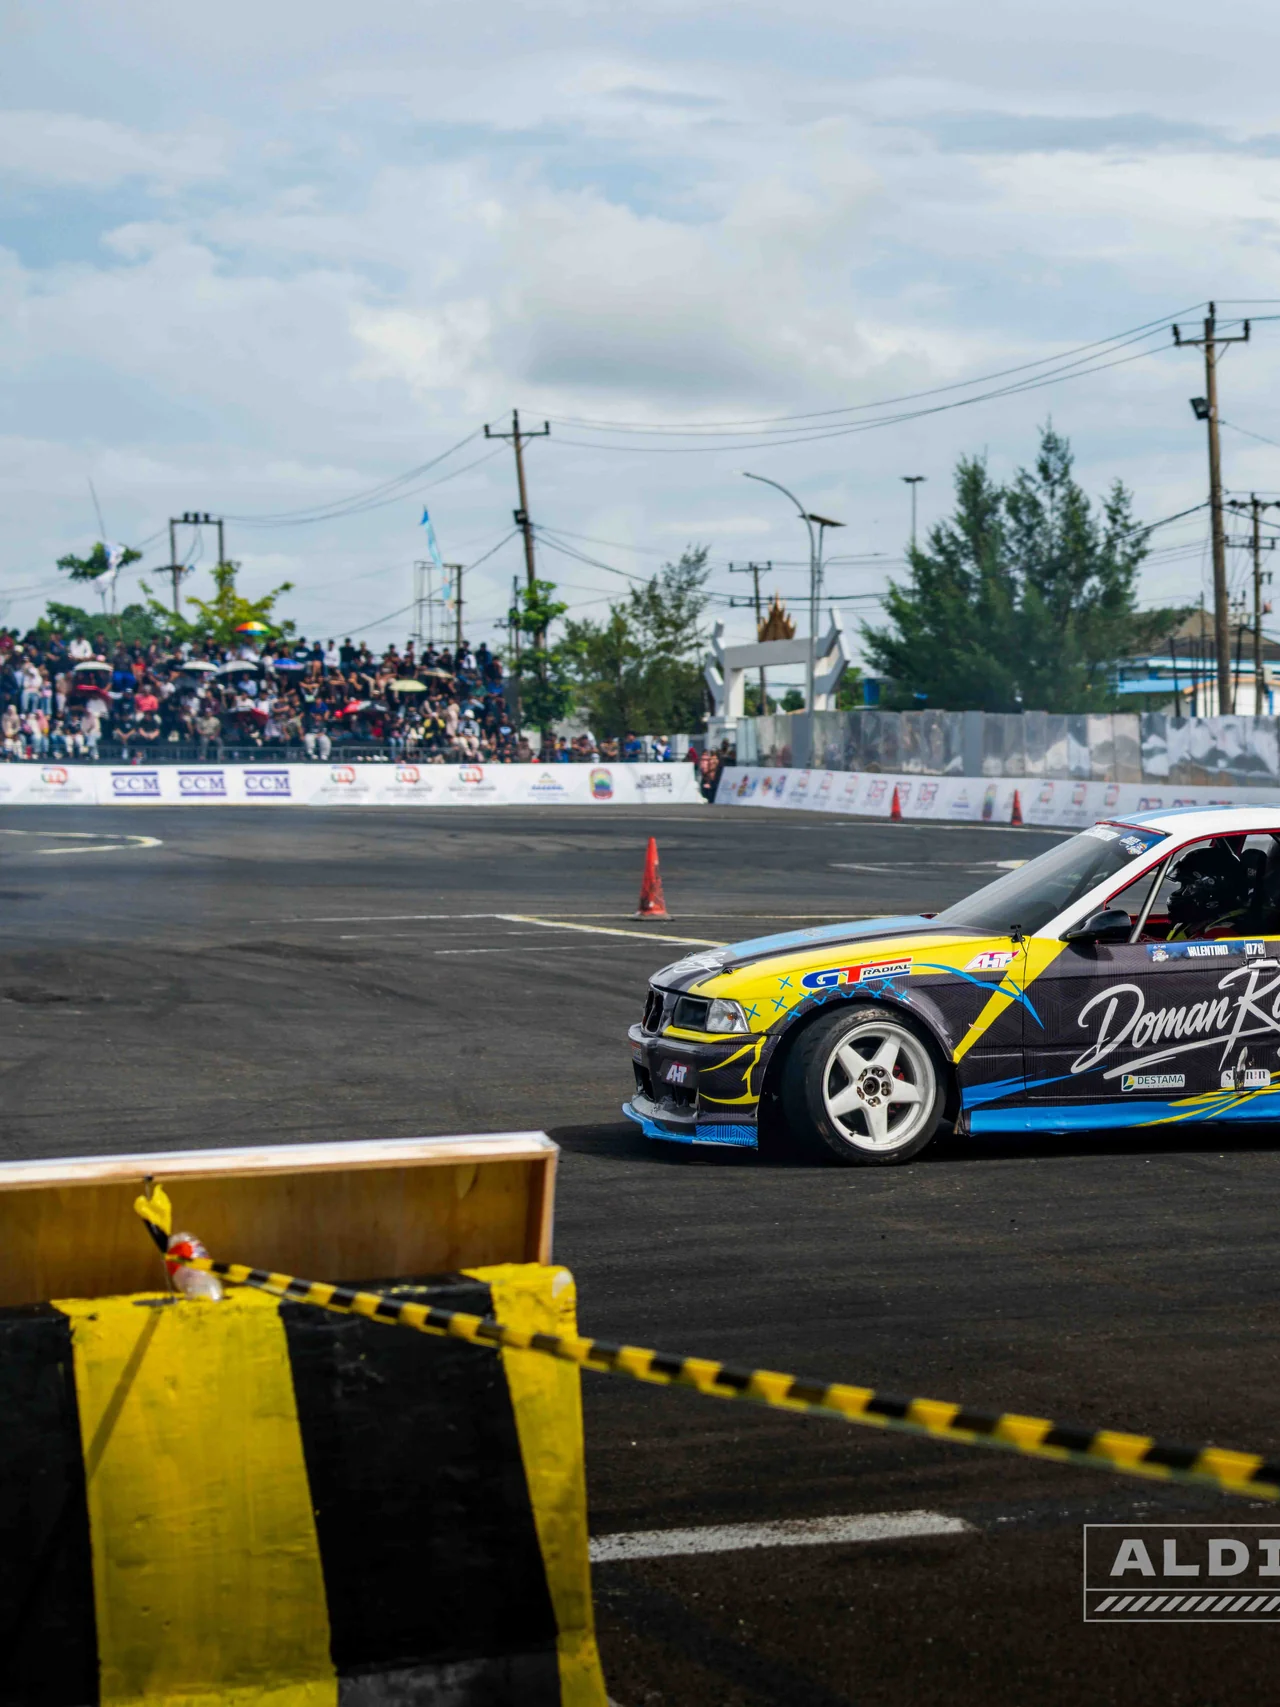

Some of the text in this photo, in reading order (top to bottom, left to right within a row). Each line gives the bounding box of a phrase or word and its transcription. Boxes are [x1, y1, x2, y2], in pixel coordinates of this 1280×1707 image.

[112, 776, 160, 790] CCM
[178, 775, 226, 789] CCM
[245, 775, 291, 789] CCM
[1187, 944, 1229, 957] VALENTINO
[1246, 942, 1265, 955] 078
[862, 964, 911, 976] RADIAL
[1071, 983, 1234, 1074] Doman
[1137, 1075, 1184, 1086] DESTAMA
